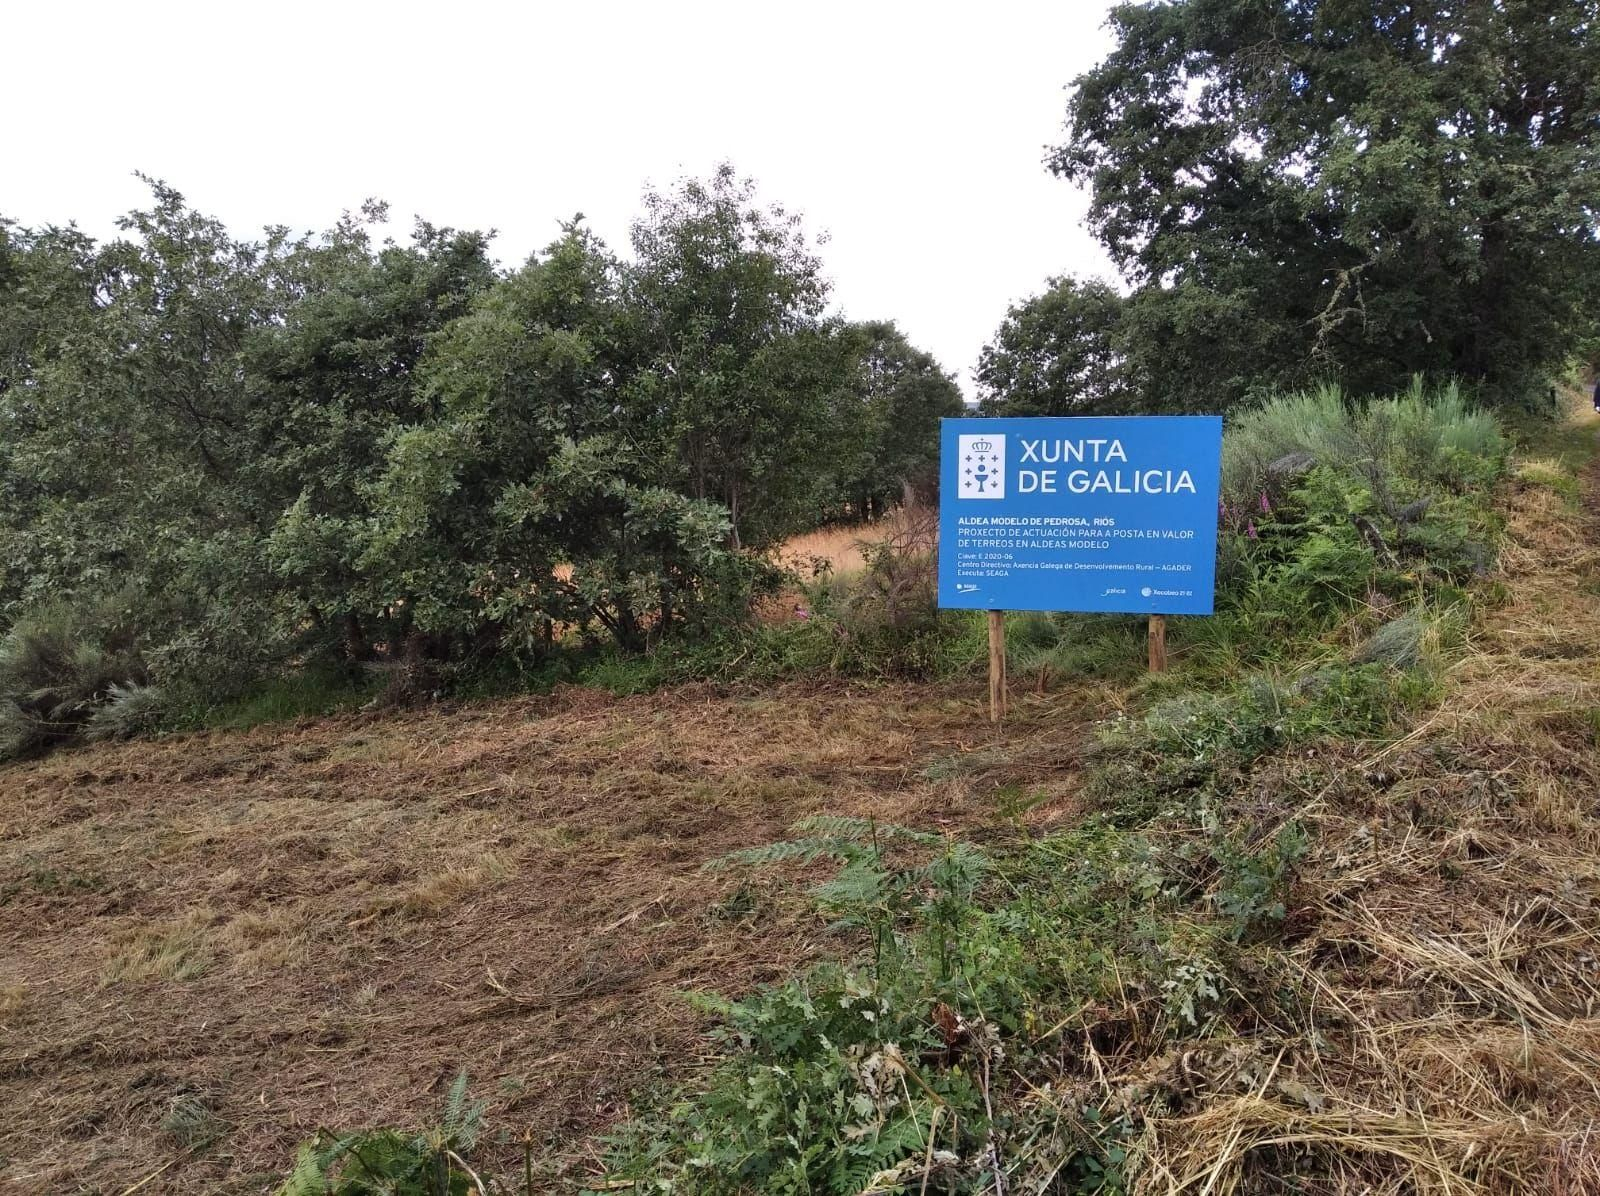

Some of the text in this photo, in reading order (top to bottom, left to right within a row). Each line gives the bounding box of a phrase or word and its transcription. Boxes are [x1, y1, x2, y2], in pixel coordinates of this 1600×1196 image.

[1020, 439, 1128, 463] XUNTA
[1018, 470, 1196, 494] DE GALICIA
[958, 517, 990, 526] ALDEA
[991, 517, 1029, 526] MODELO
[1030, 517, 1042, 526] DE
[1044, 517, 1090, 527] PEDROSA,
[958, 527, 1194, 539] PROXECTO DE ACTUACIÓN PARA A POSTA EN VALOR
[958, 539, 1109, 549] DE TERREOS EN ALDEAS MODELO
[1040, 562, 1063, 570] Galega
[986, 569, 1009, 577] SEAGA
